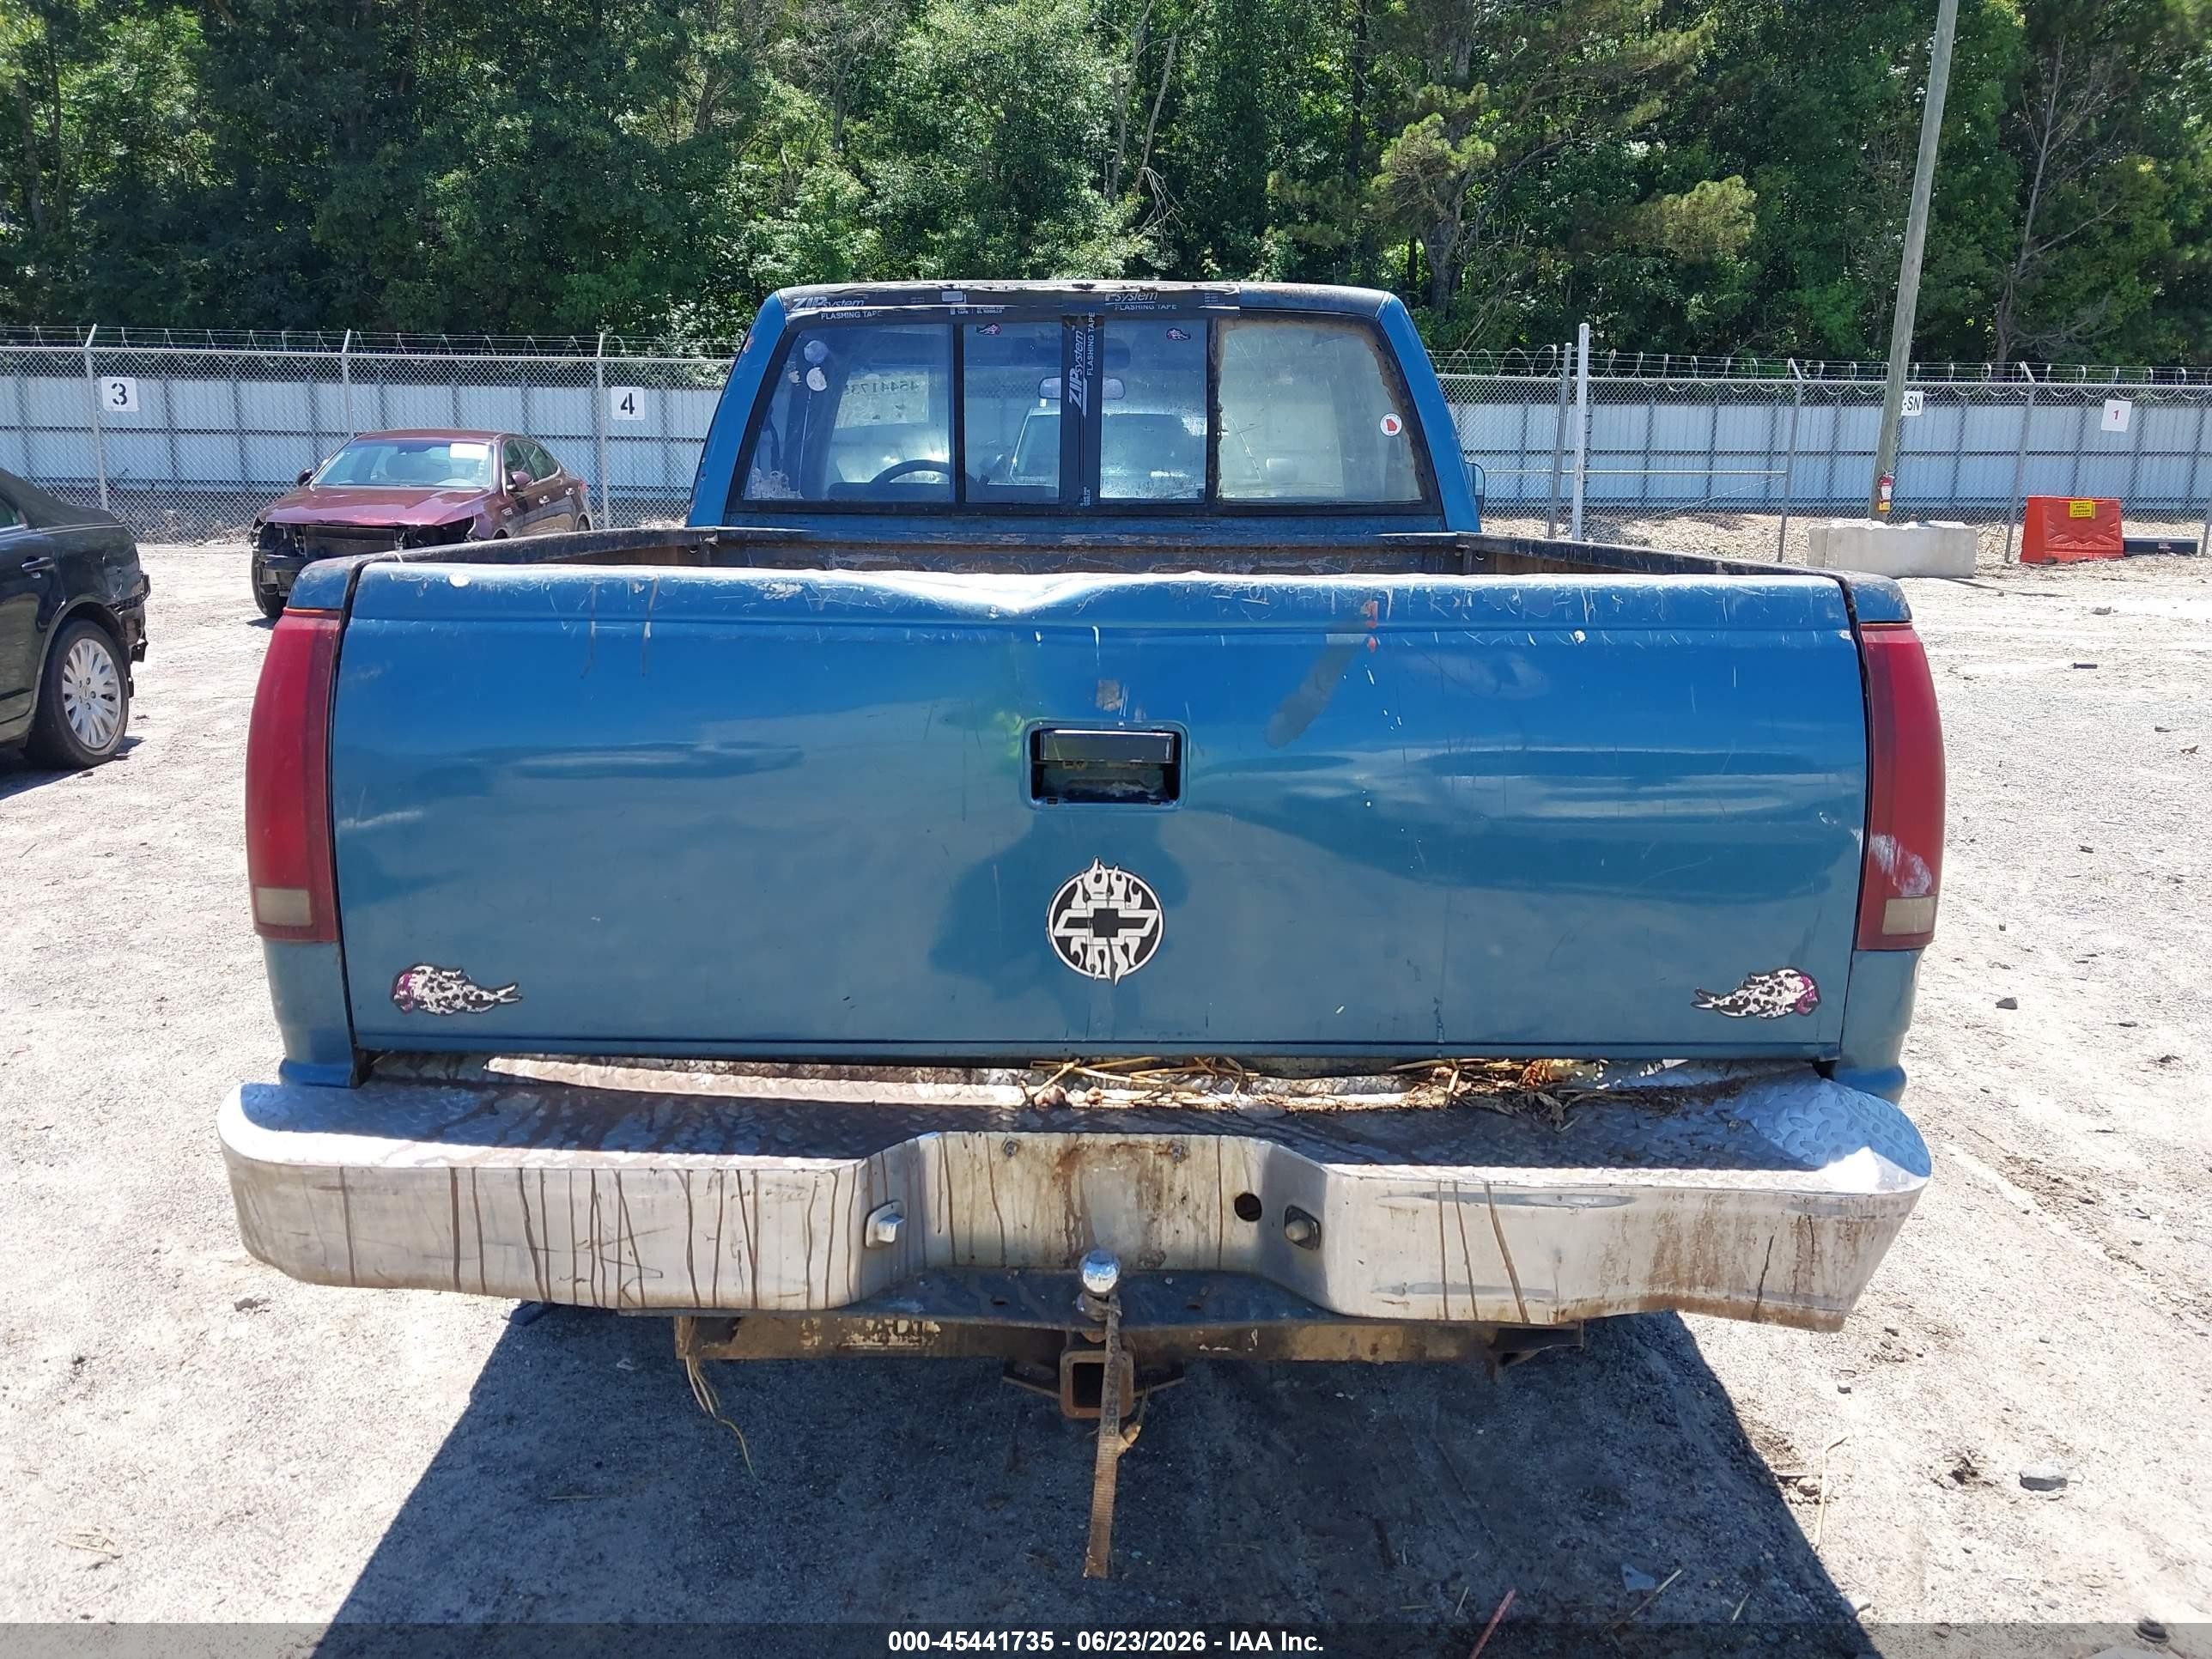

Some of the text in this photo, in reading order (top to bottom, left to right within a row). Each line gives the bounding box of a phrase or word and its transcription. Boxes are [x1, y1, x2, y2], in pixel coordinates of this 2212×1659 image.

[821, 312, 860, 320] FLASHING
[1086, 311, 1096, 376] FLASHING TAPE
[111, 382, 128, 405] 3
[1901, 395, 1921, 411] -SN
[620, 392, 635, 415] 4
[2113, 409, 2119, 420] 1
